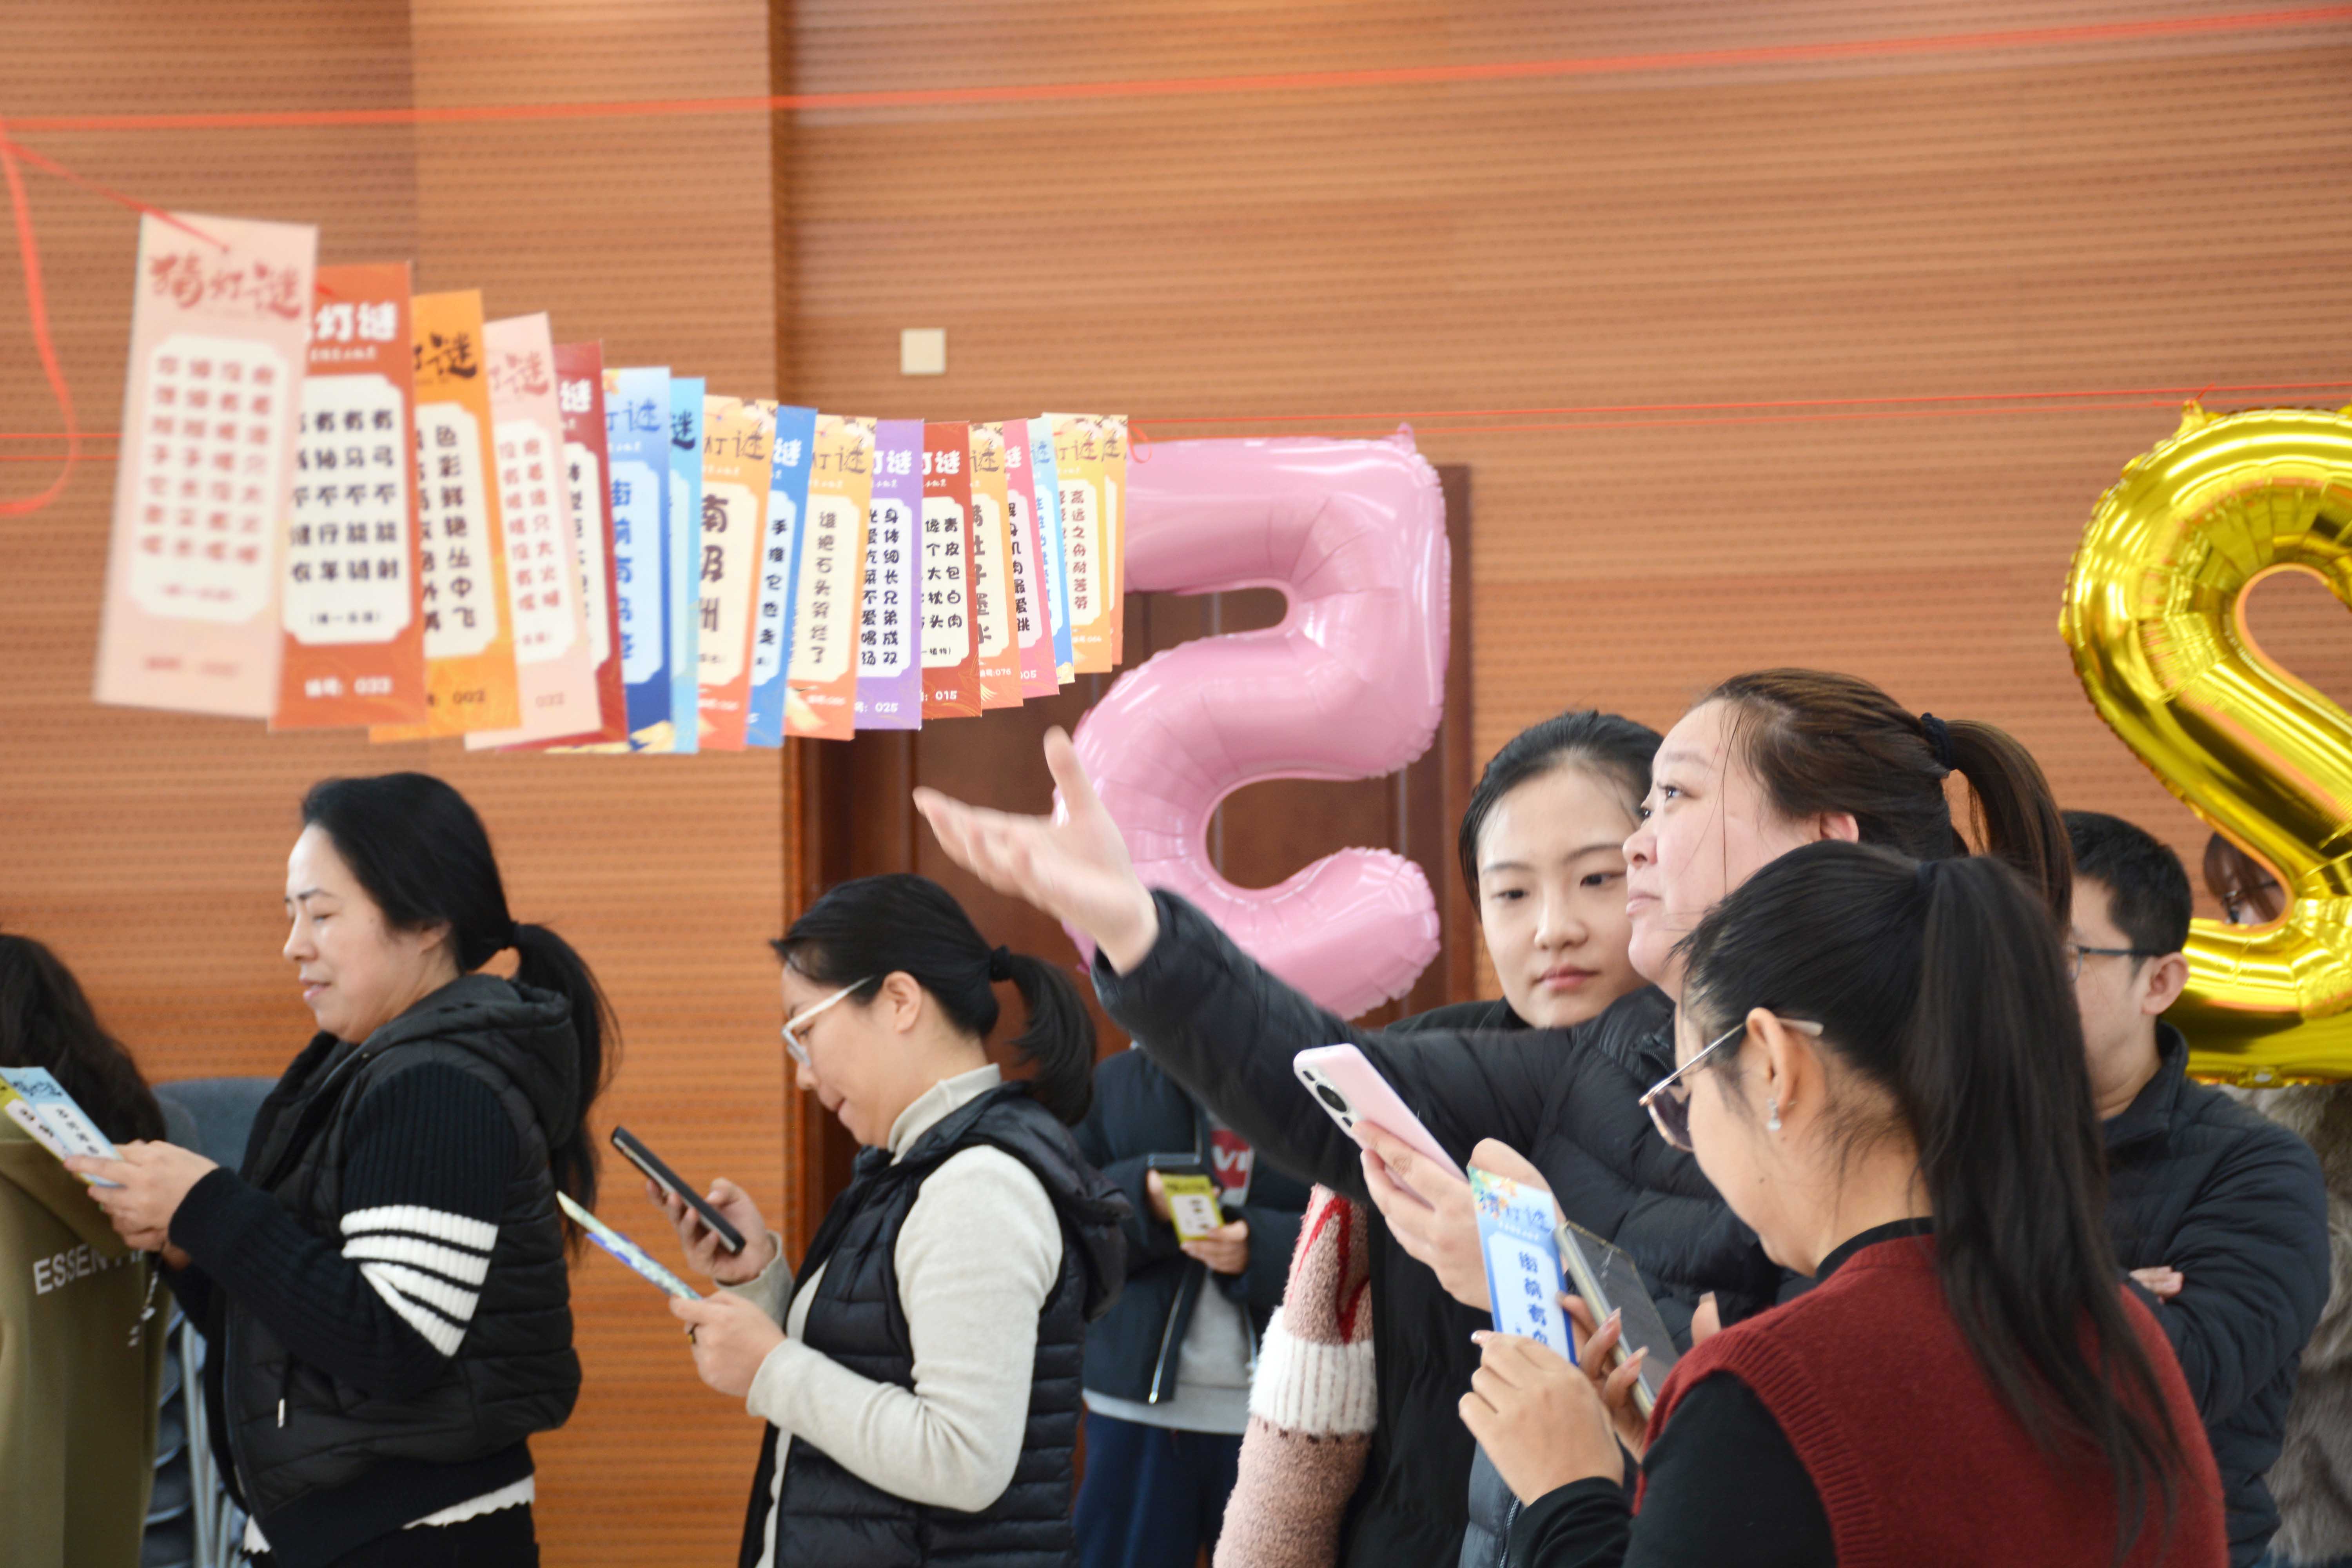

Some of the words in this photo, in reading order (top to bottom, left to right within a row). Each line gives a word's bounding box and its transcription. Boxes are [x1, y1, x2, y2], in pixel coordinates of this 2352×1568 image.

[303, 301, 397, 342] 灯谜
[883, 508, 899, 665] 身体细长兄弟成双
